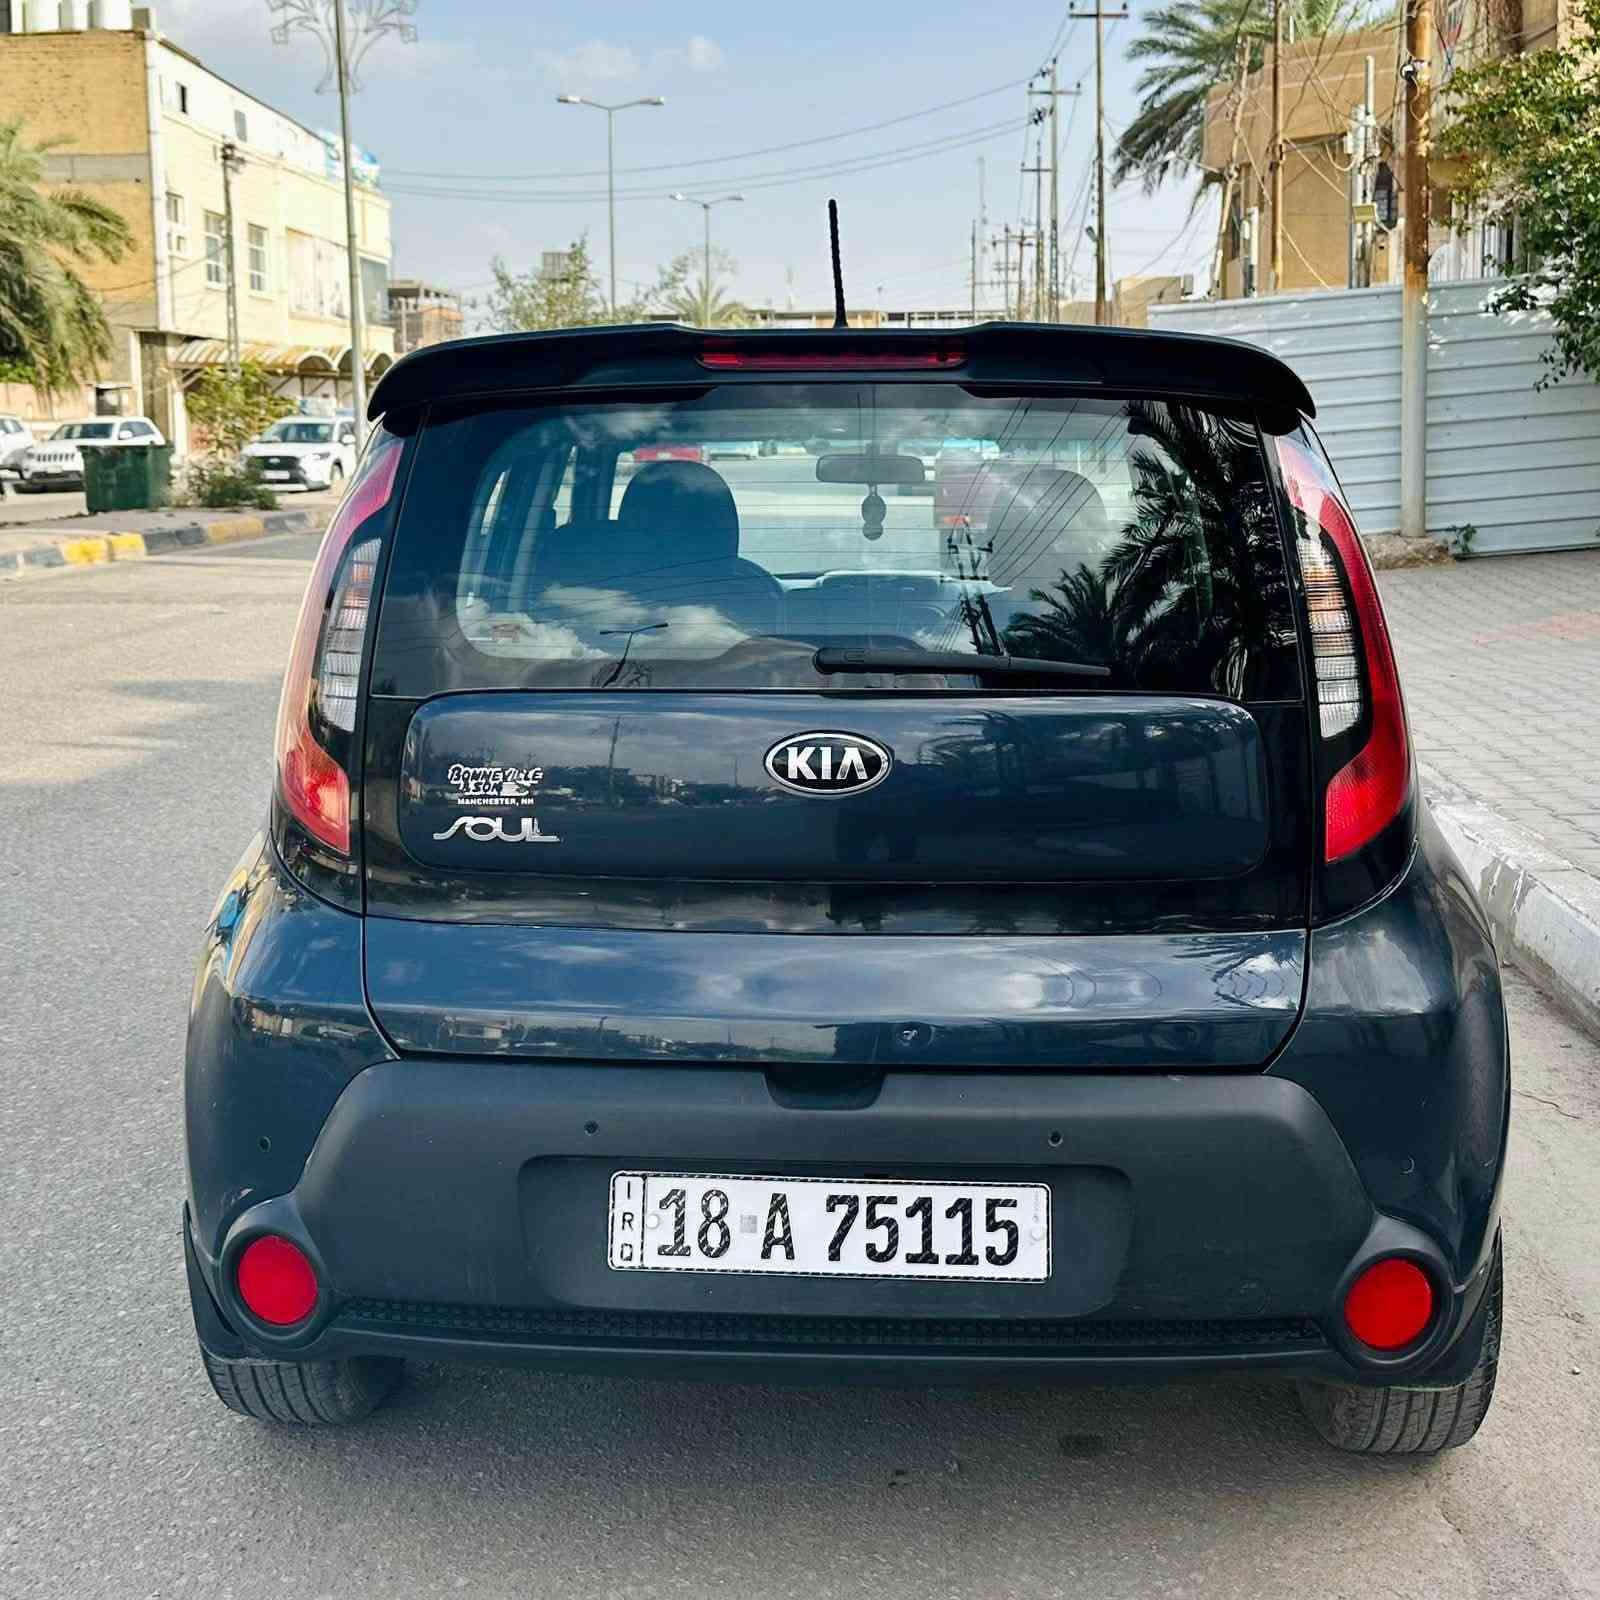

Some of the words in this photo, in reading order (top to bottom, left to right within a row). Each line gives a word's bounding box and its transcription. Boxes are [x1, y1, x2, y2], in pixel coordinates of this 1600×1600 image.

[786, 746, 868, 780] KIA
[457, 797, 519, 807] MANCHESTER,
[432, 816, 561, 842] SOUL
[657, 1188, 731, 1259] 18
[760, 1192, 796, 1261] A
[825, 1194, 1019, 1267] 75115
